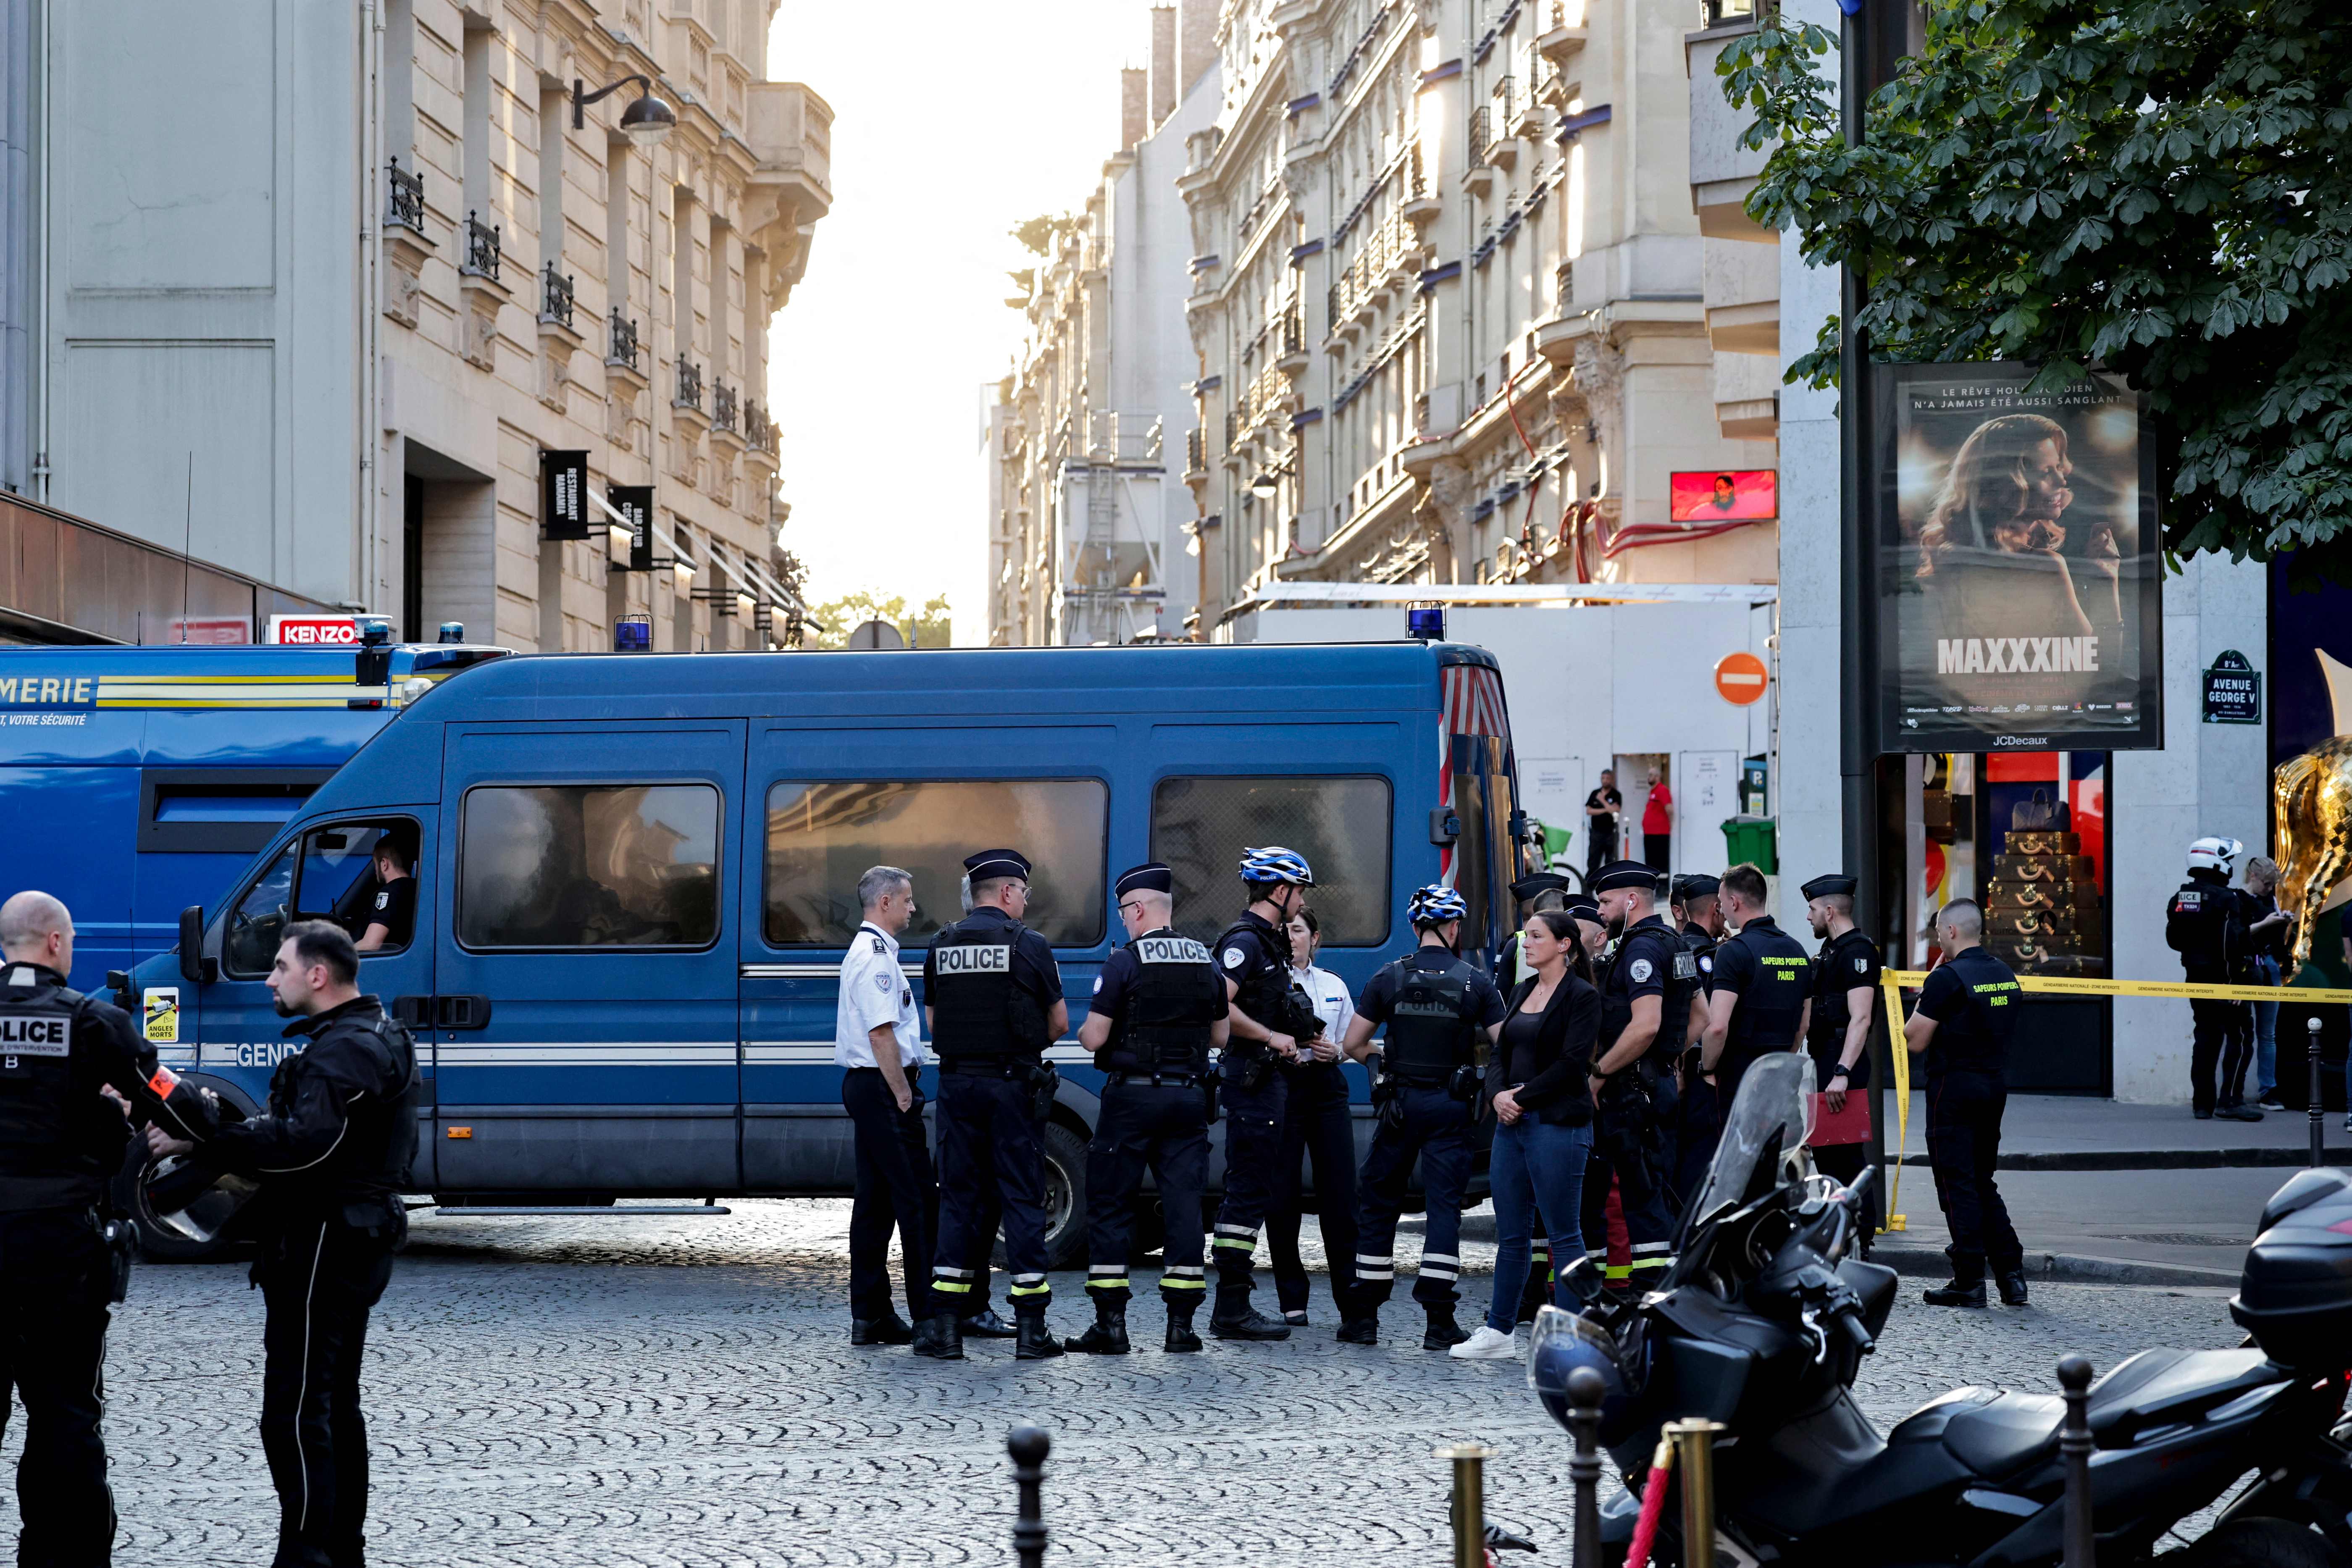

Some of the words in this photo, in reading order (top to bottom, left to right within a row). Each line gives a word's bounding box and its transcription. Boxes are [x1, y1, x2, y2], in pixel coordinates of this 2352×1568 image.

[1962, 387, 1991, 396] RÊVE
[1941, 399, 1985, 407] JAMAIS
[1991, 397, 2011, 406] ÉTÉ
[2017, 397, 2052, 406] AUSSI
[2058, 396, 2121, 405] SANGLANT
[567, 468, 578, 521] RESTAURANT
[633, 508, 643, 525] BAR
[633, 526, 643, 548] CLUB
[285, 625, 355, 643] KENZO
[1938, 636, 2099, 674] MAXXXINE
[2213, 678, 2252, 691] AVENUE
[2209, 691, 2246, 703] GEORGE
[2249, 693, 2255, 704] V
[9, 715, 40, 725] VOTRE
[40, 713, 87, 726] SÉCURITÉ
[1993, 736, 2048, 746] JCDecaux
[1142, 940, 1207, 961] POLICE
[939, 948, 1004, 971] POLICE
[1761, 956, 1785, 966] SAPEURS
[1777, 970, 1795, 981] PARIS
[1973, 982, 1997, 993] SAPEURS
[1997, 981, 2019, 991] POMPIERS
[1990, 995, 2008, 1007] PARIS
[0, 1021, 63, 1043] LICE
[5, 1055, 18, 1069] B
